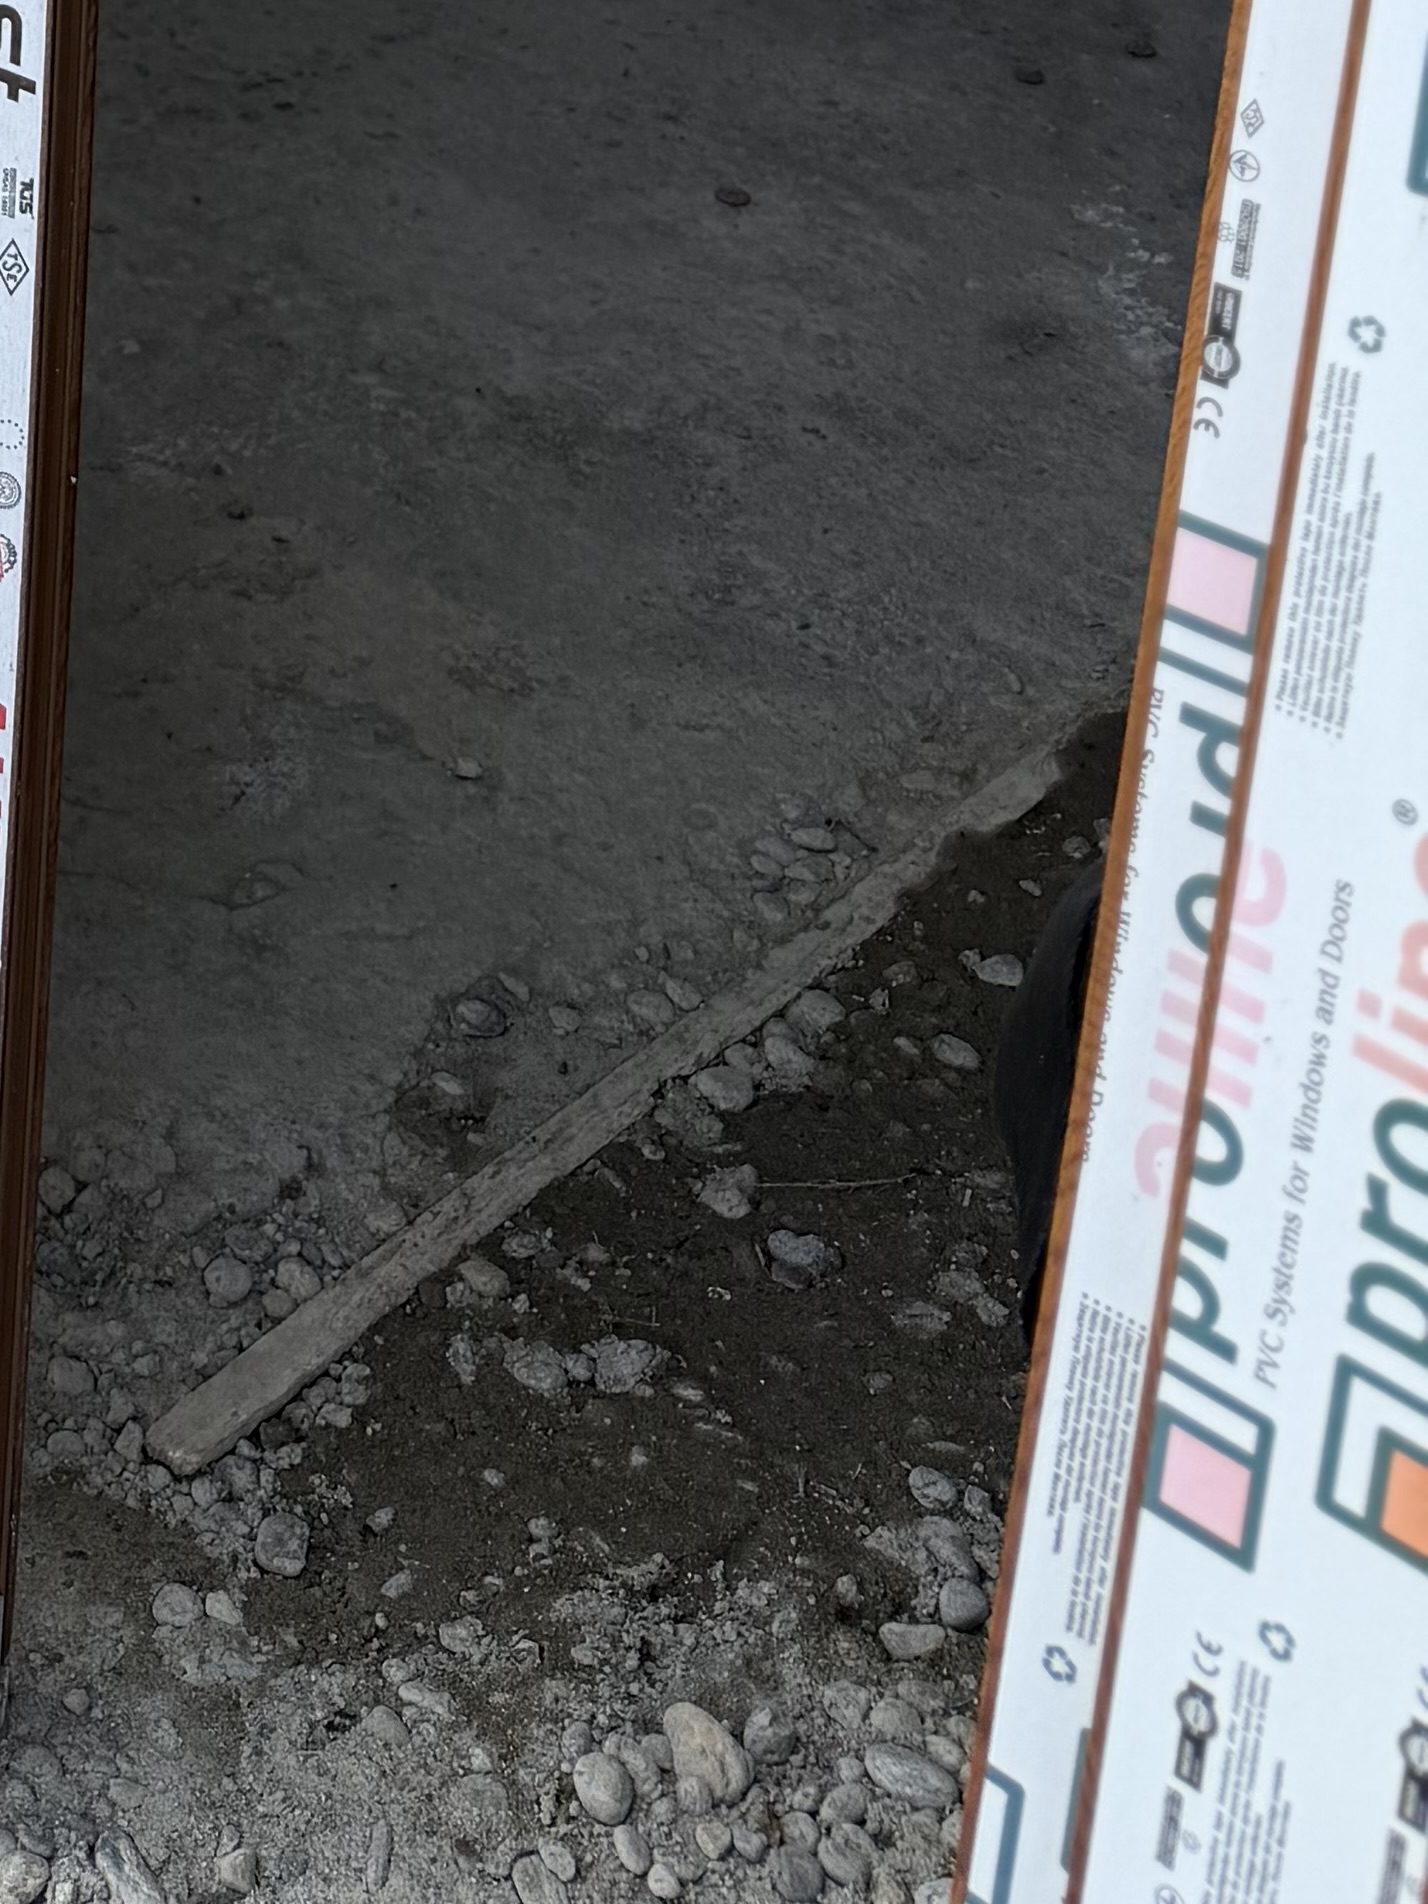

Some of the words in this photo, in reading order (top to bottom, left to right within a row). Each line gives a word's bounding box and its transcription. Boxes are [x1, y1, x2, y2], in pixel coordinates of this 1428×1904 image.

[1320, 878, 1356, 971] Doors
[1314, 971, 1341, 1027] and
[1289, 1029, 1332, 1159] Windows
